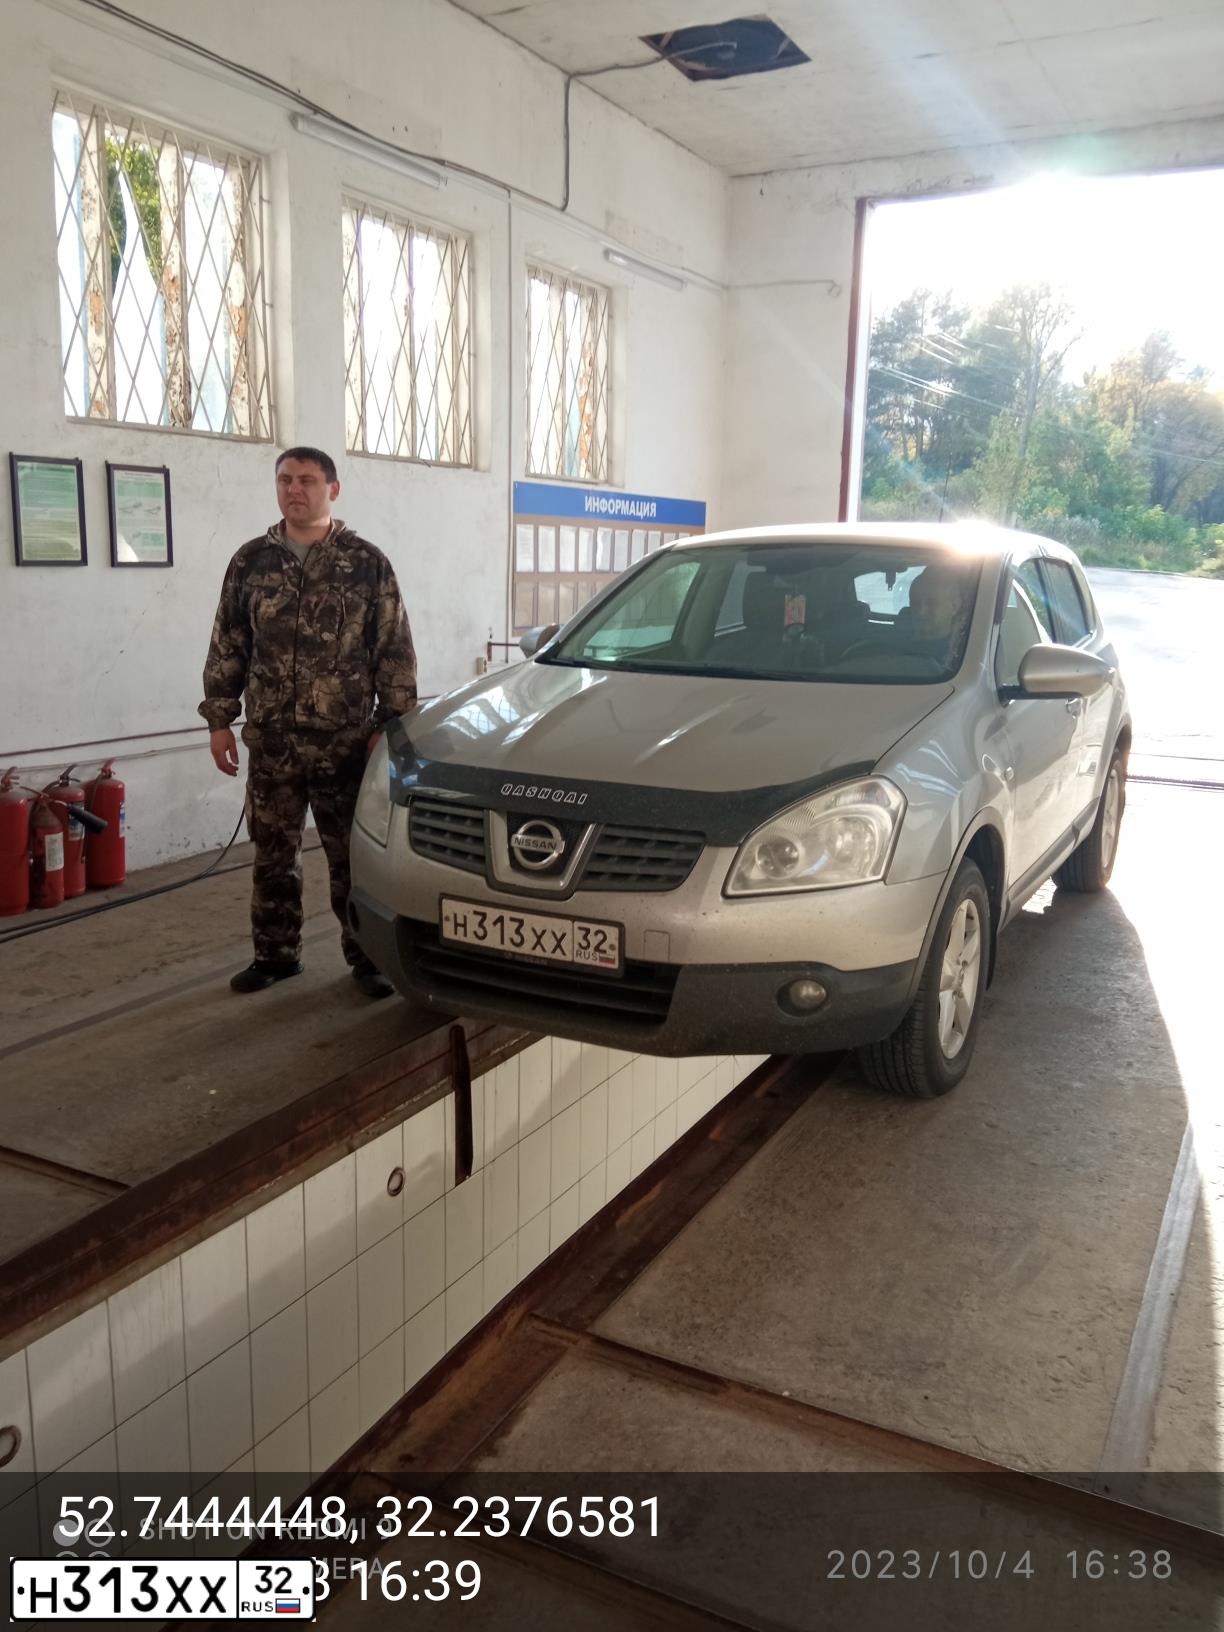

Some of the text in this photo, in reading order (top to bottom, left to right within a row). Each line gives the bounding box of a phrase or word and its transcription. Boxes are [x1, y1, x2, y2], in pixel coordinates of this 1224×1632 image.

[584, 496, 657, 520] ИНФОРМАЦИЯ
[513, 836, 557, 850] NISSAN
[577, 926, 608, 954] 32
[575, 951, 598, 962] RUS
